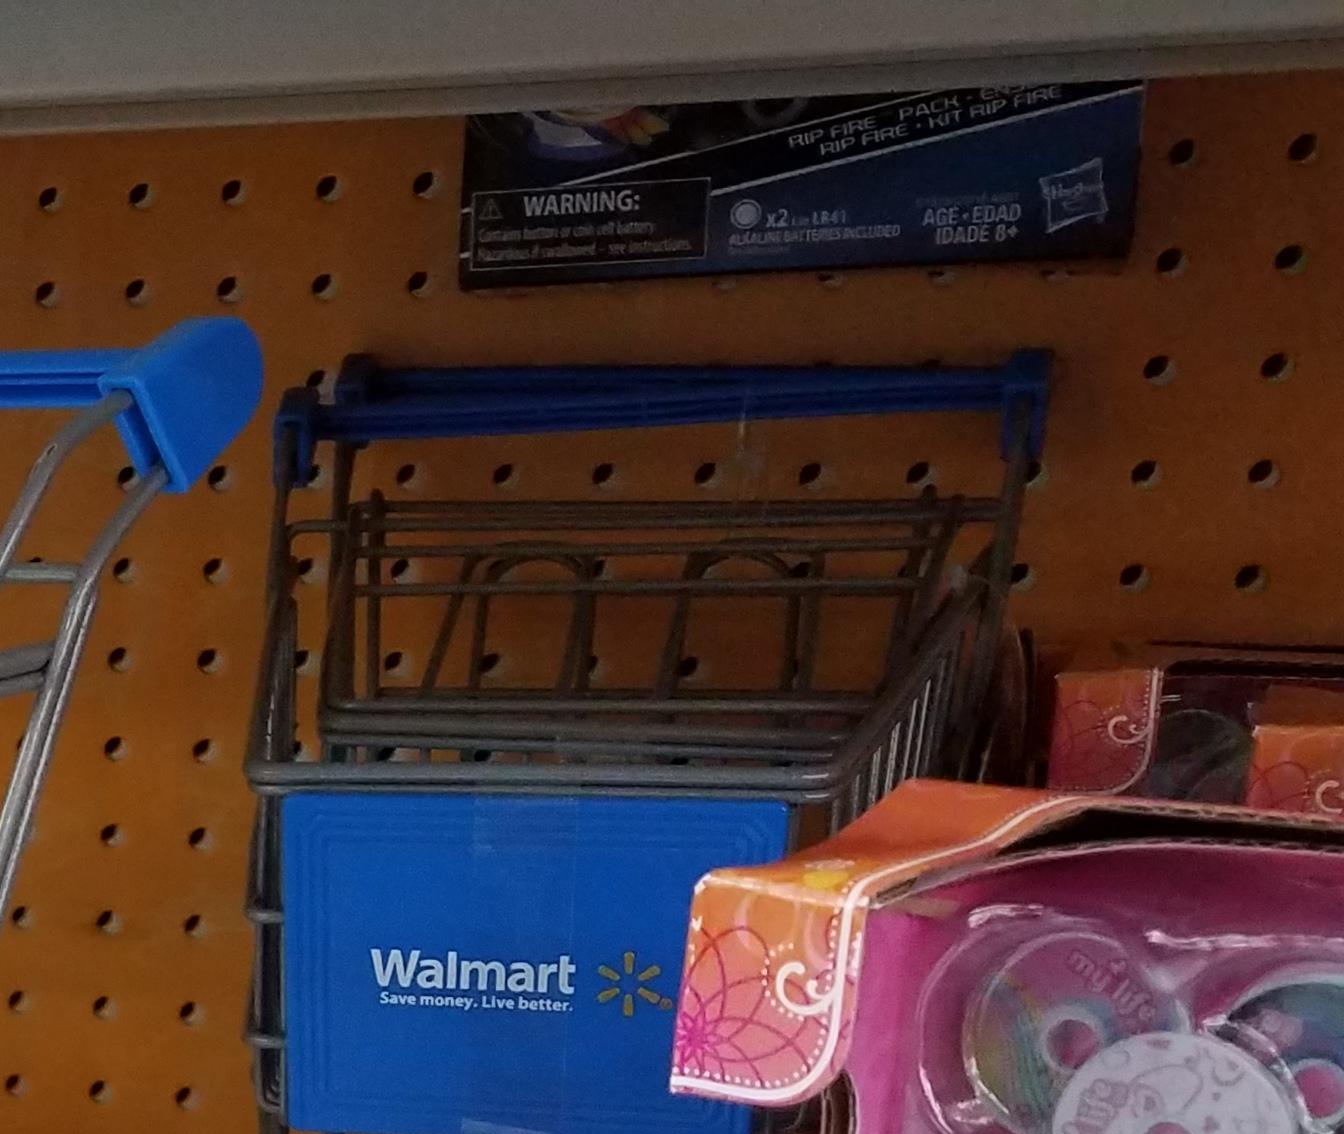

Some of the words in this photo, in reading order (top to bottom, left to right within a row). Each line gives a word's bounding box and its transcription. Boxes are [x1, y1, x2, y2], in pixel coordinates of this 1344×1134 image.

[788, 129, 824, 149] RIP
[830, 115, 879, 139] FIRE
[898, 94, 960, 122] PACK
[819, 136, 855, 156] RIP
[861, 123, 909, 147] FIRE
[928, 109, 963, 130] KIT
[968, 99, 1007, 118] RIP
[1013, 86, 1063, 109] FIRE
[522, 190, 641, 217] WARNING:
[922, 207, 960, 227] AGE
[972, 203, 1022, 223] EDAD
[935, 225, 990, 245] IDADE
[369, 948, 576, 995] Walmart
[379, 992, 417, 1007] Save
[419, 997, 478, 1012] money.
[481, 995, 516, 1011] Live
[518, 997, 574, 1013] better.
